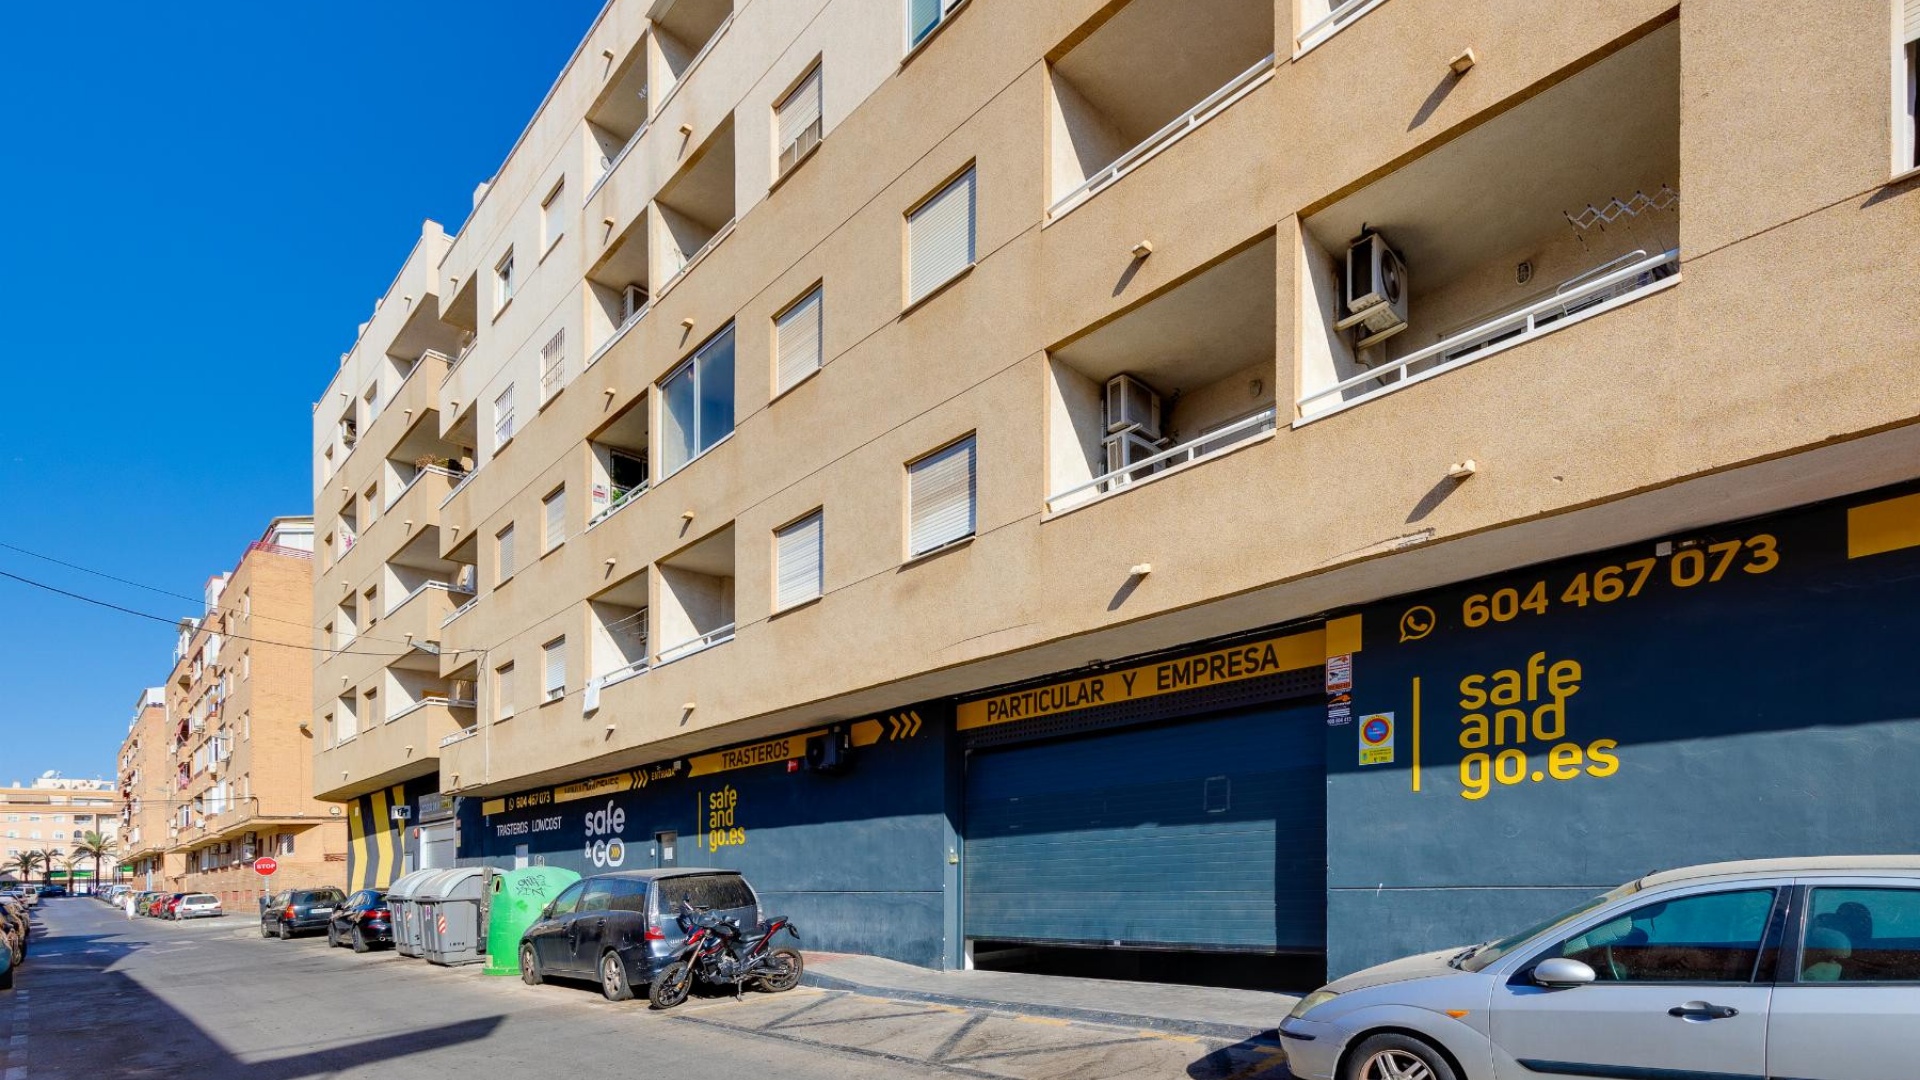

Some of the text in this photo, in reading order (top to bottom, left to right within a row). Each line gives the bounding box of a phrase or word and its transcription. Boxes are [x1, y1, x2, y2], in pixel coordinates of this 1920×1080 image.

[1462, 534, 1780, 628] 604 467 073
[987, 643, 1279, 722] PARTICULAR Y EMPRESA
[1459, 651, 1582, 710] safe
[1459, 694, 1566, 750] and
[721, 740, 790, 769] TRASTEROS
[1459, 738, 1620, 800] go.es
[709, 784, 737, 811] safe
[496, 816, 562, 837] TRASTEROS LOWCOST
[584, 800, 626, 837] safe
[709, 806, 734, 829] and
[709, 826, 746, 853] go.es
